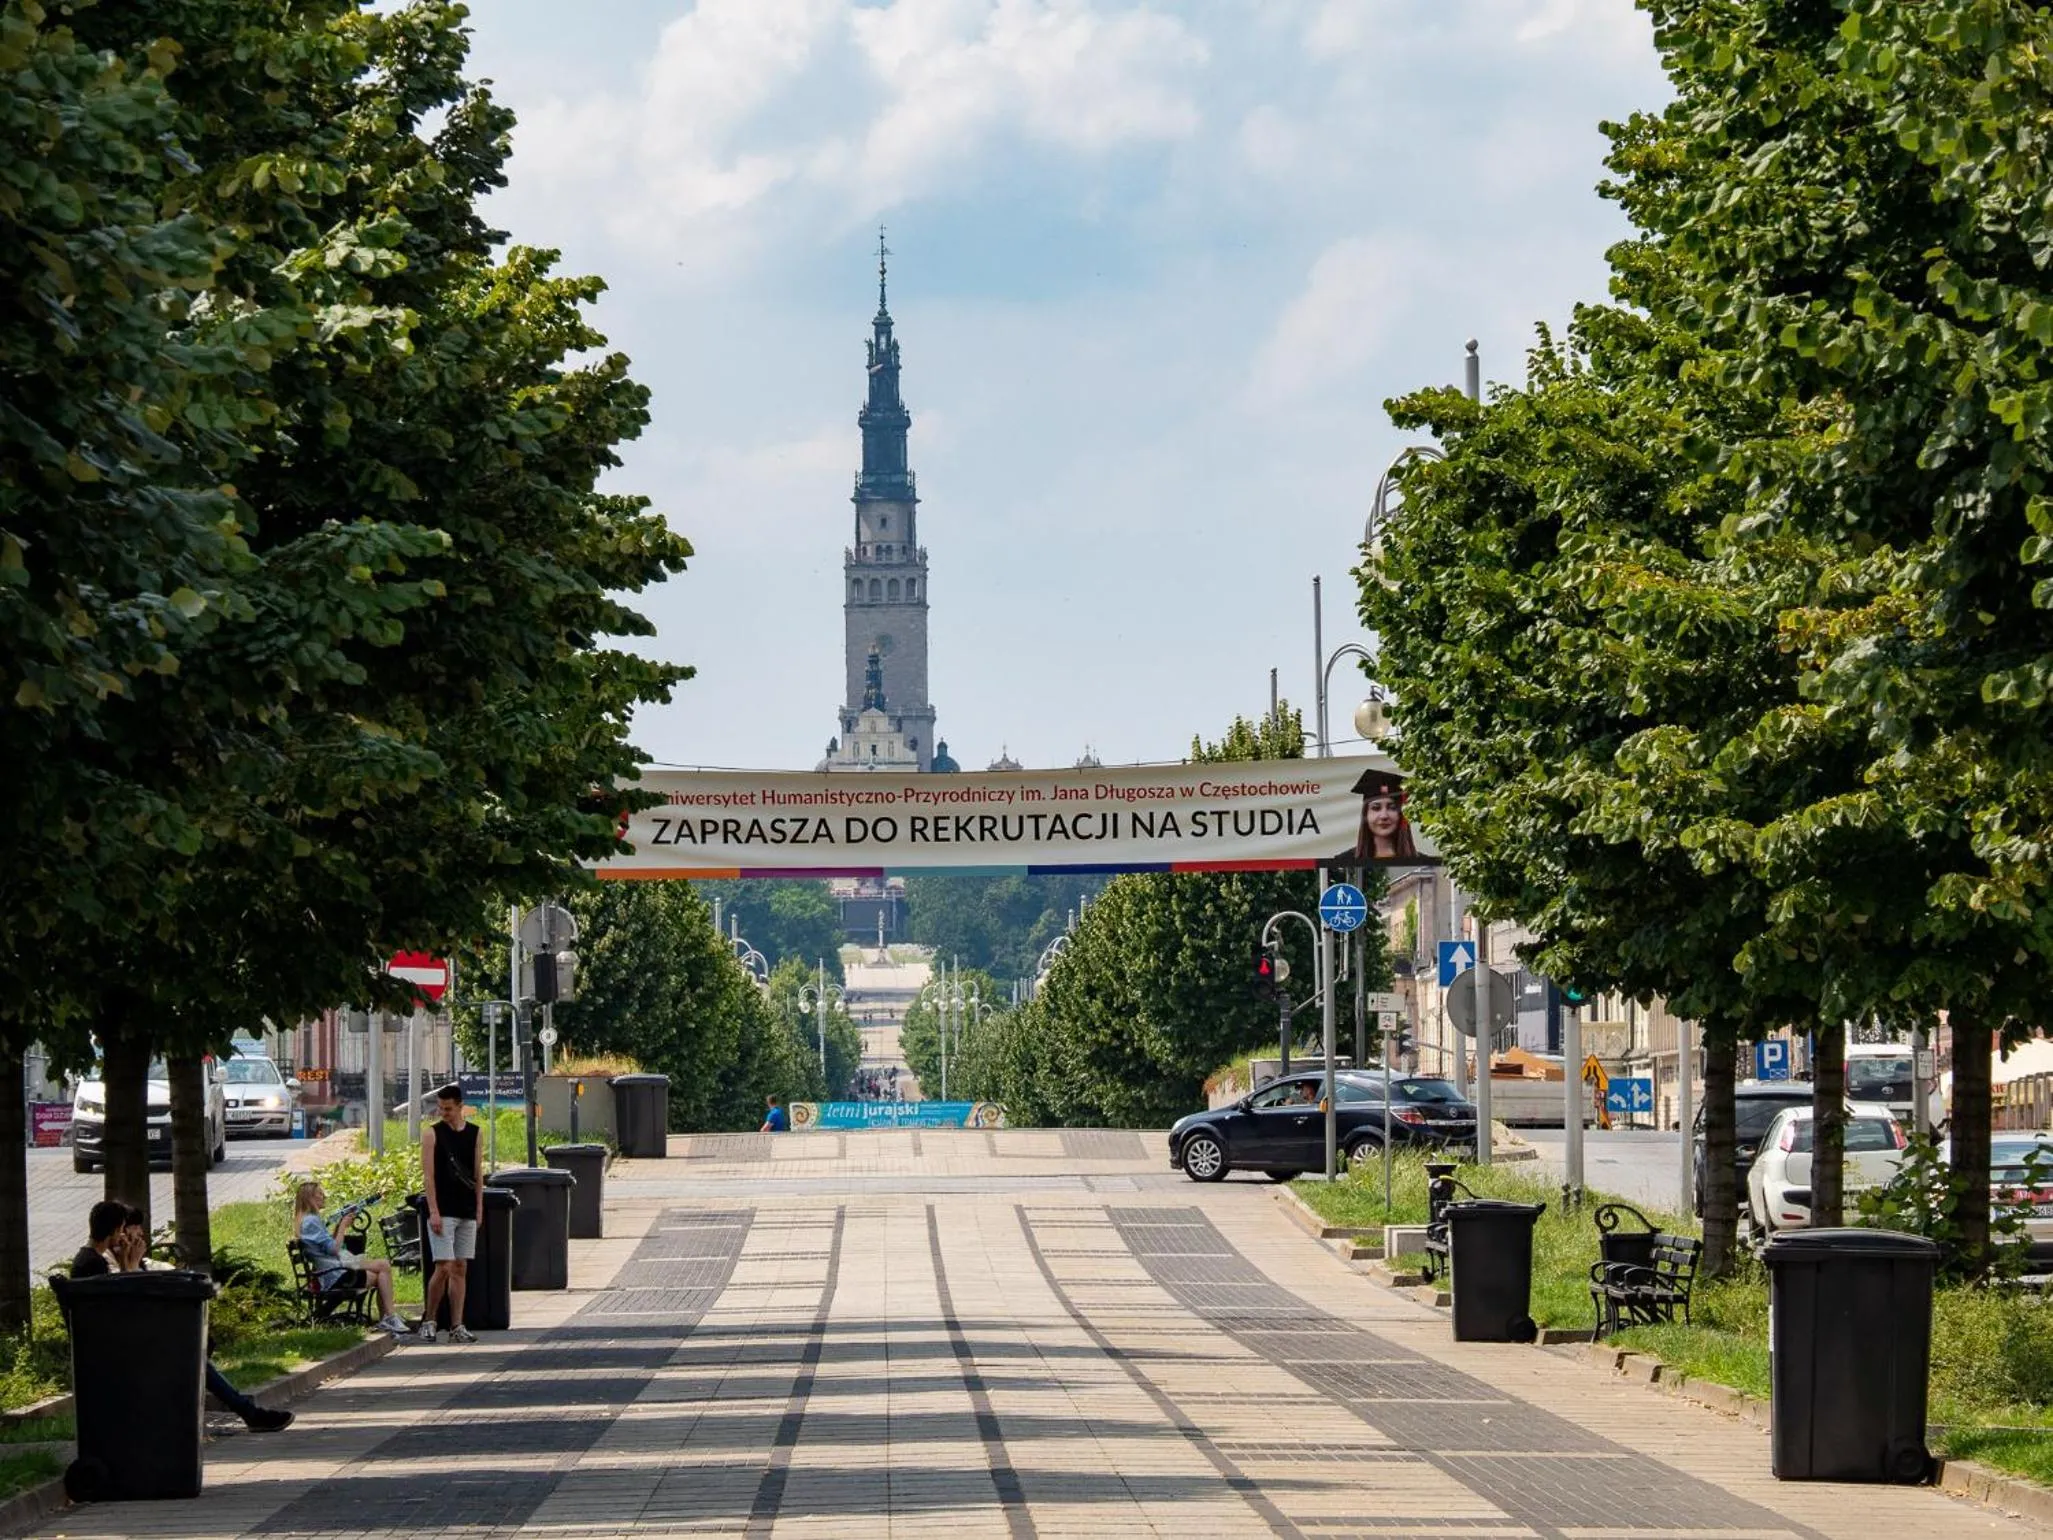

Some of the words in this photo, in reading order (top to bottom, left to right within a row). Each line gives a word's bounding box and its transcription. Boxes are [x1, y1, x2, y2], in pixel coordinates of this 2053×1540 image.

[664, 789, 756, 808] niwersytet
[762, 785, 1016, 807] Humanistyczno-Przyrodniczy
[1021, 785, 1046, 801] im.
[1050, 784, 1089, 802] Jana
[1095, 783, 1175, 803] Długosza
[1179, 786, 1195, 798] w
[1199, 779, 1321, 801] Częstochowie
[651, 816, 835, 845] ZAPRASZA
[846, 815, 898, 843] DO
[910, 811, 1119, 843] REKRUTACJI
[1132, 811, 1182, 839] NA
[1190, 807, 1321, 838] STUDIA
[1763, 1043, 1783, 1069] P
[826, 1103, 861, 1119] letni
[862, 1102, 920, 1120] jurajski
